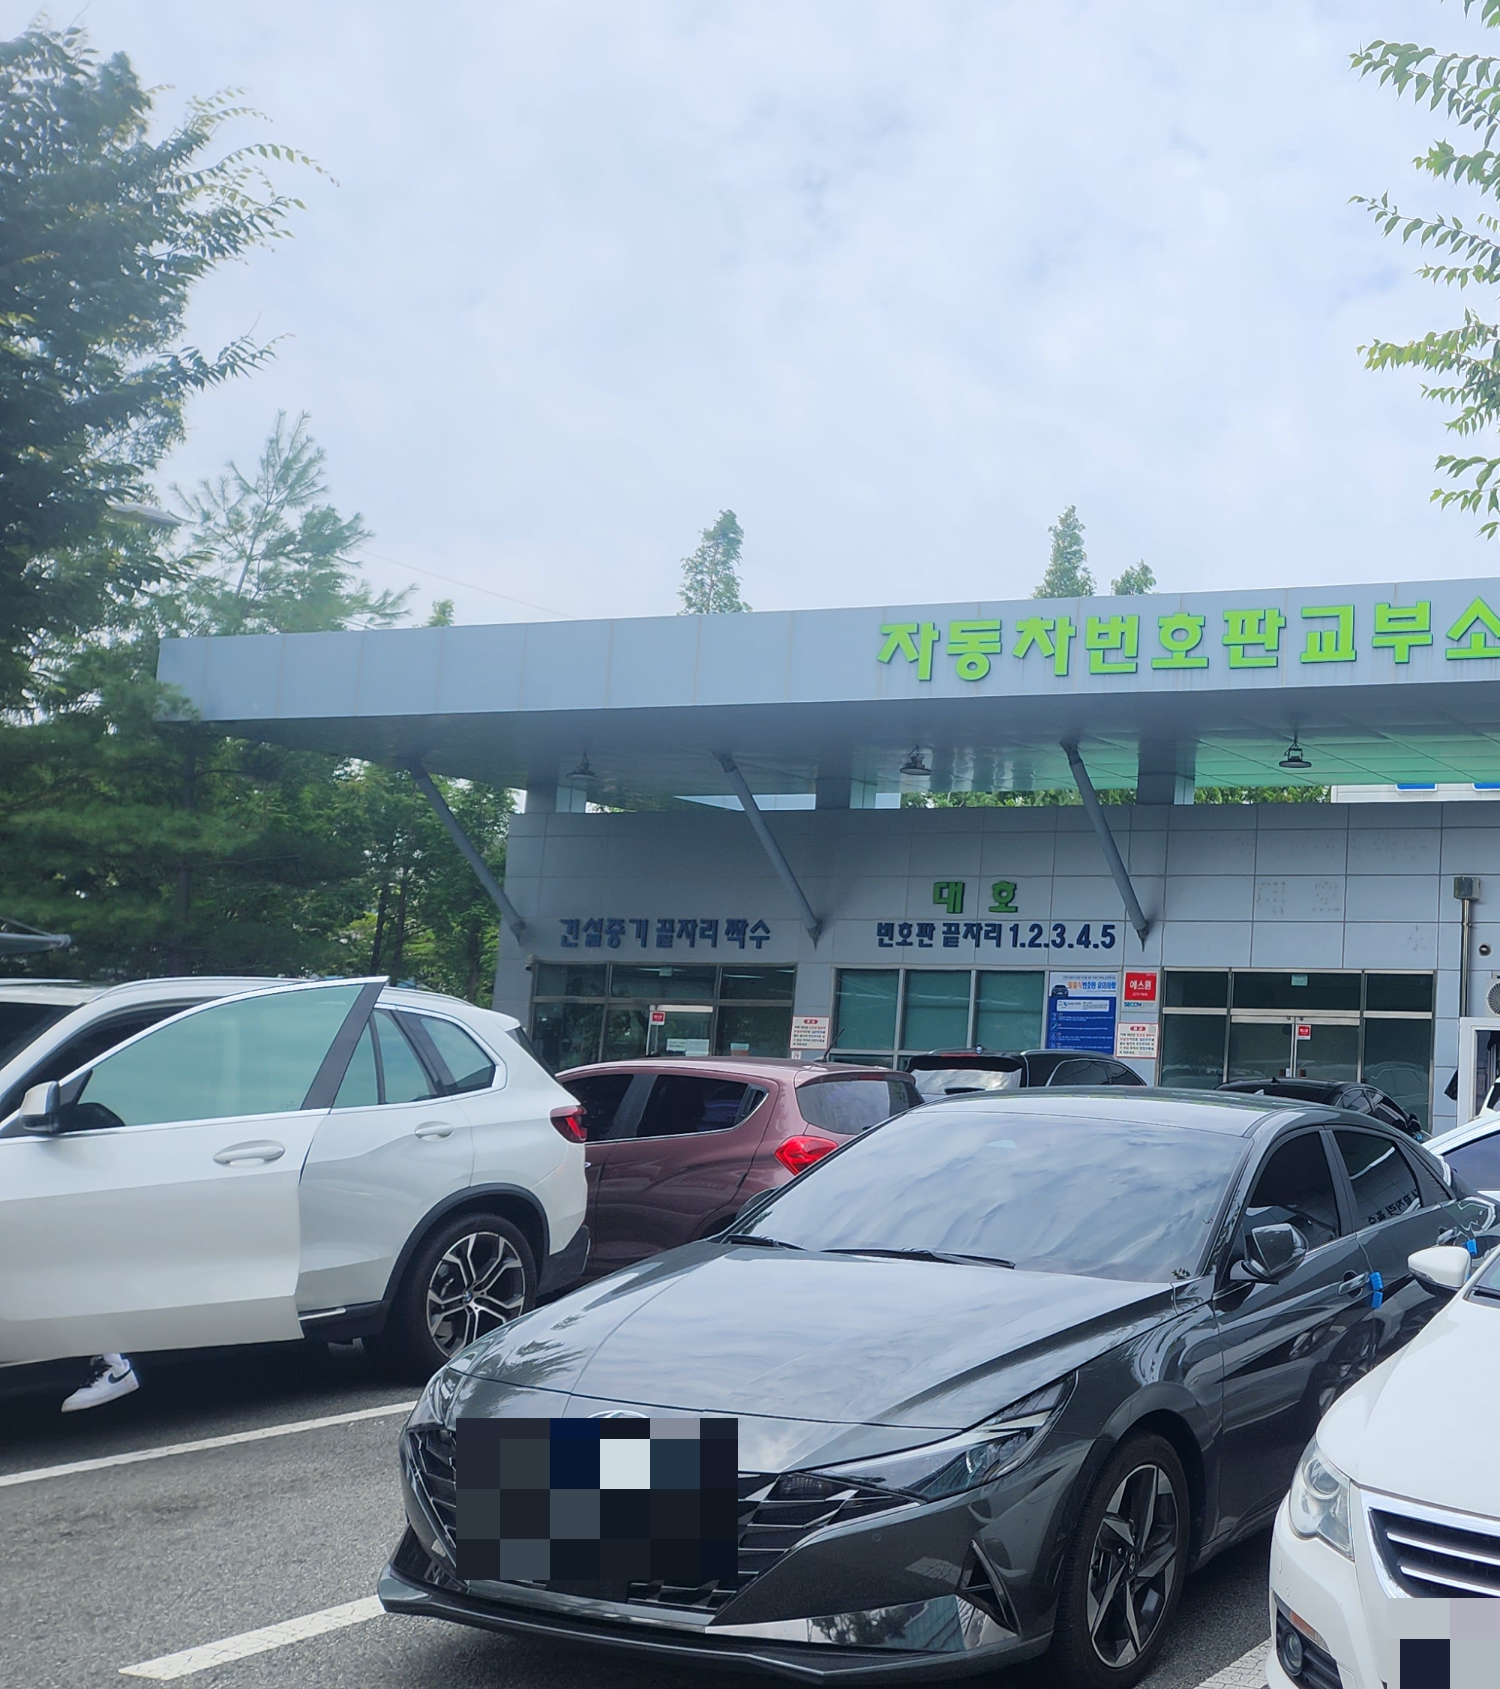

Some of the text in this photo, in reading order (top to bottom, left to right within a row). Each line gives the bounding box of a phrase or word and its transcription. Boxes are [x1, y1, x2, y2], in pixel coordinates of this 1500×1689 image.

[559, 918, 771, 950] 건설중기 끝자리 짝수
[876, 922, 1117, 949] 번호판 끝자리 1.2.3.4.5
[1130, 980, 1151, 990] 에스원
